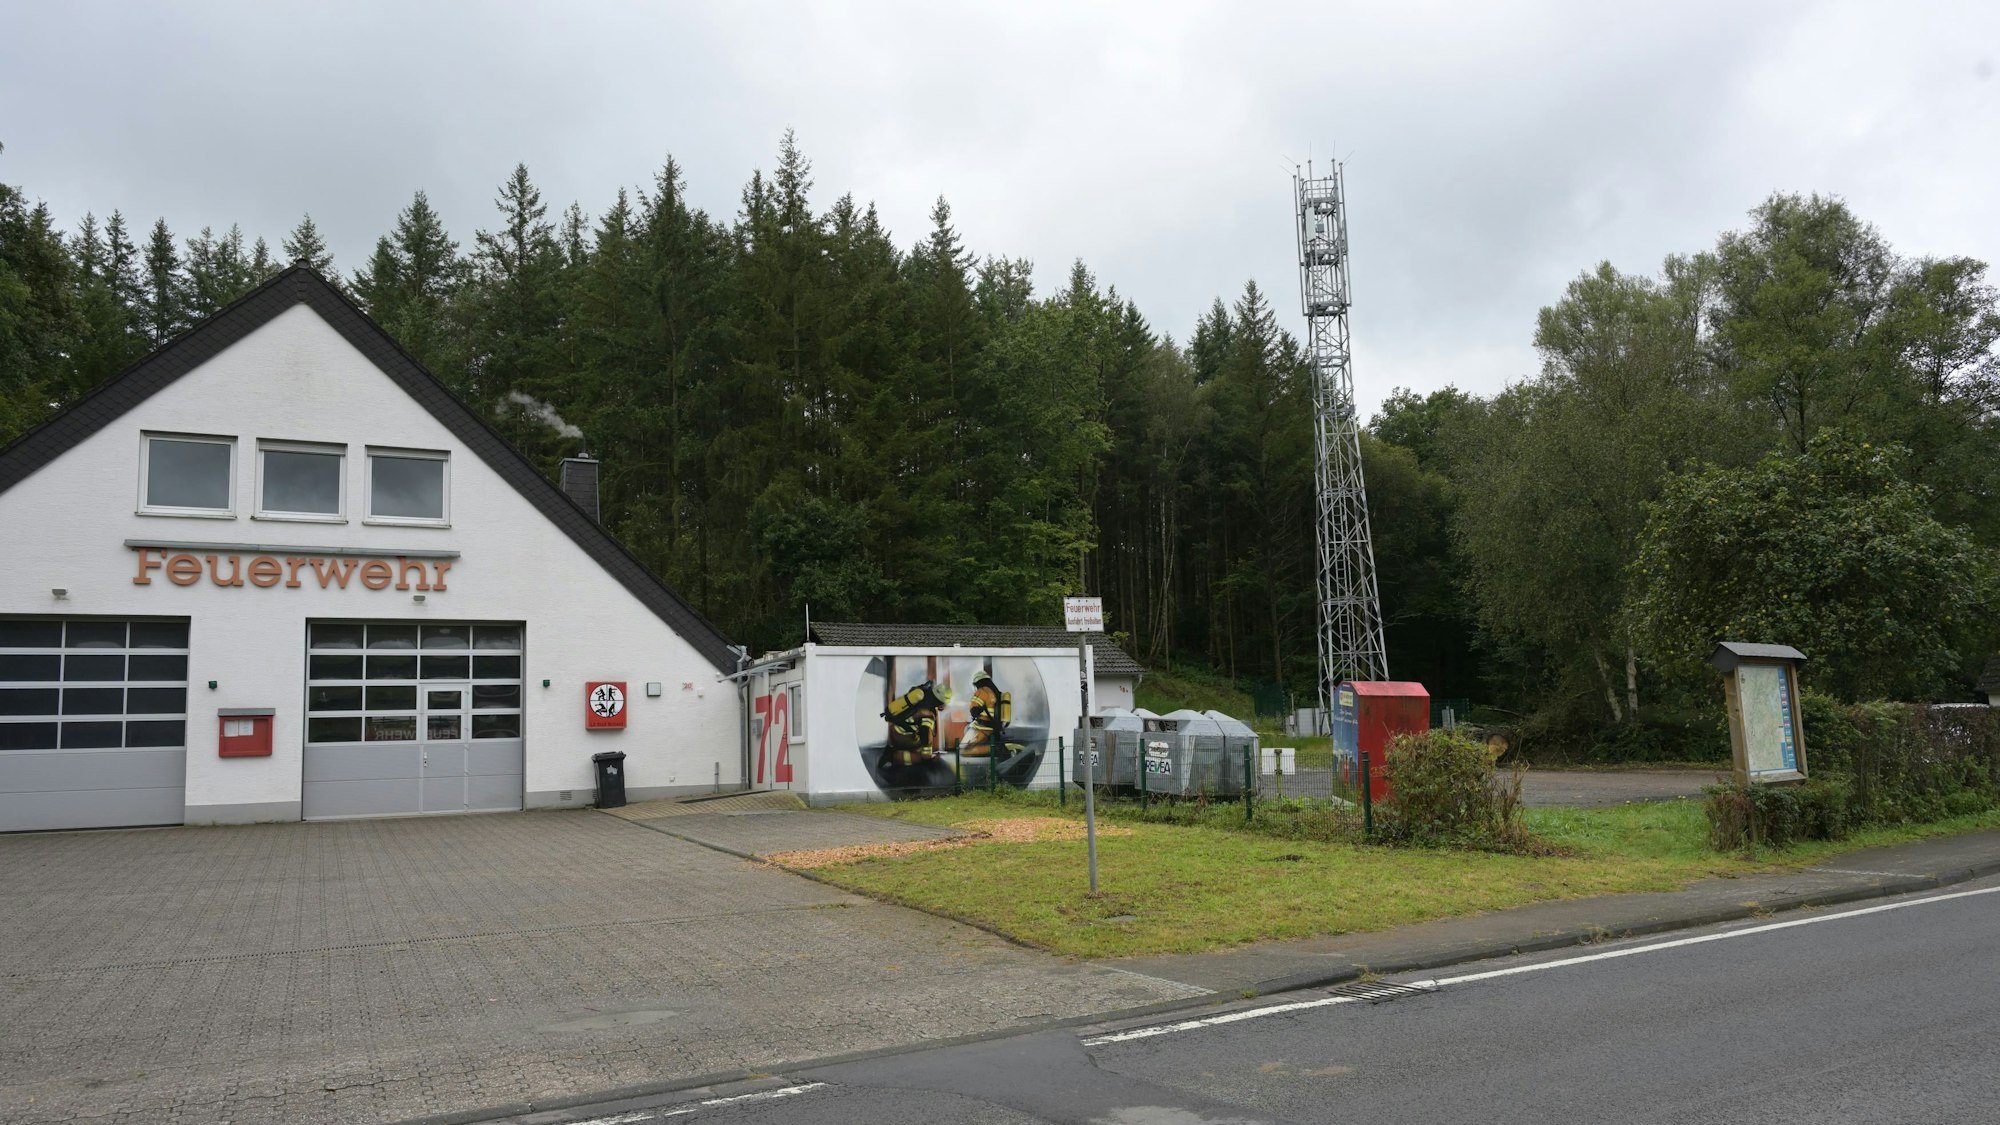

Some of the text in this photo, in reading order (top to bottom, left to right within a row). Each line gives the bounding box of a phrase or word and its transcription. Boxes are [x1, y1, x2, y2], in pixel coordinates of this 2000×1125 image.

[133, 549, 452, 591] Feuerwehr
[1066, 602, 1100, 613] Feuerwehr
[755, 692, 793, 784] 72
